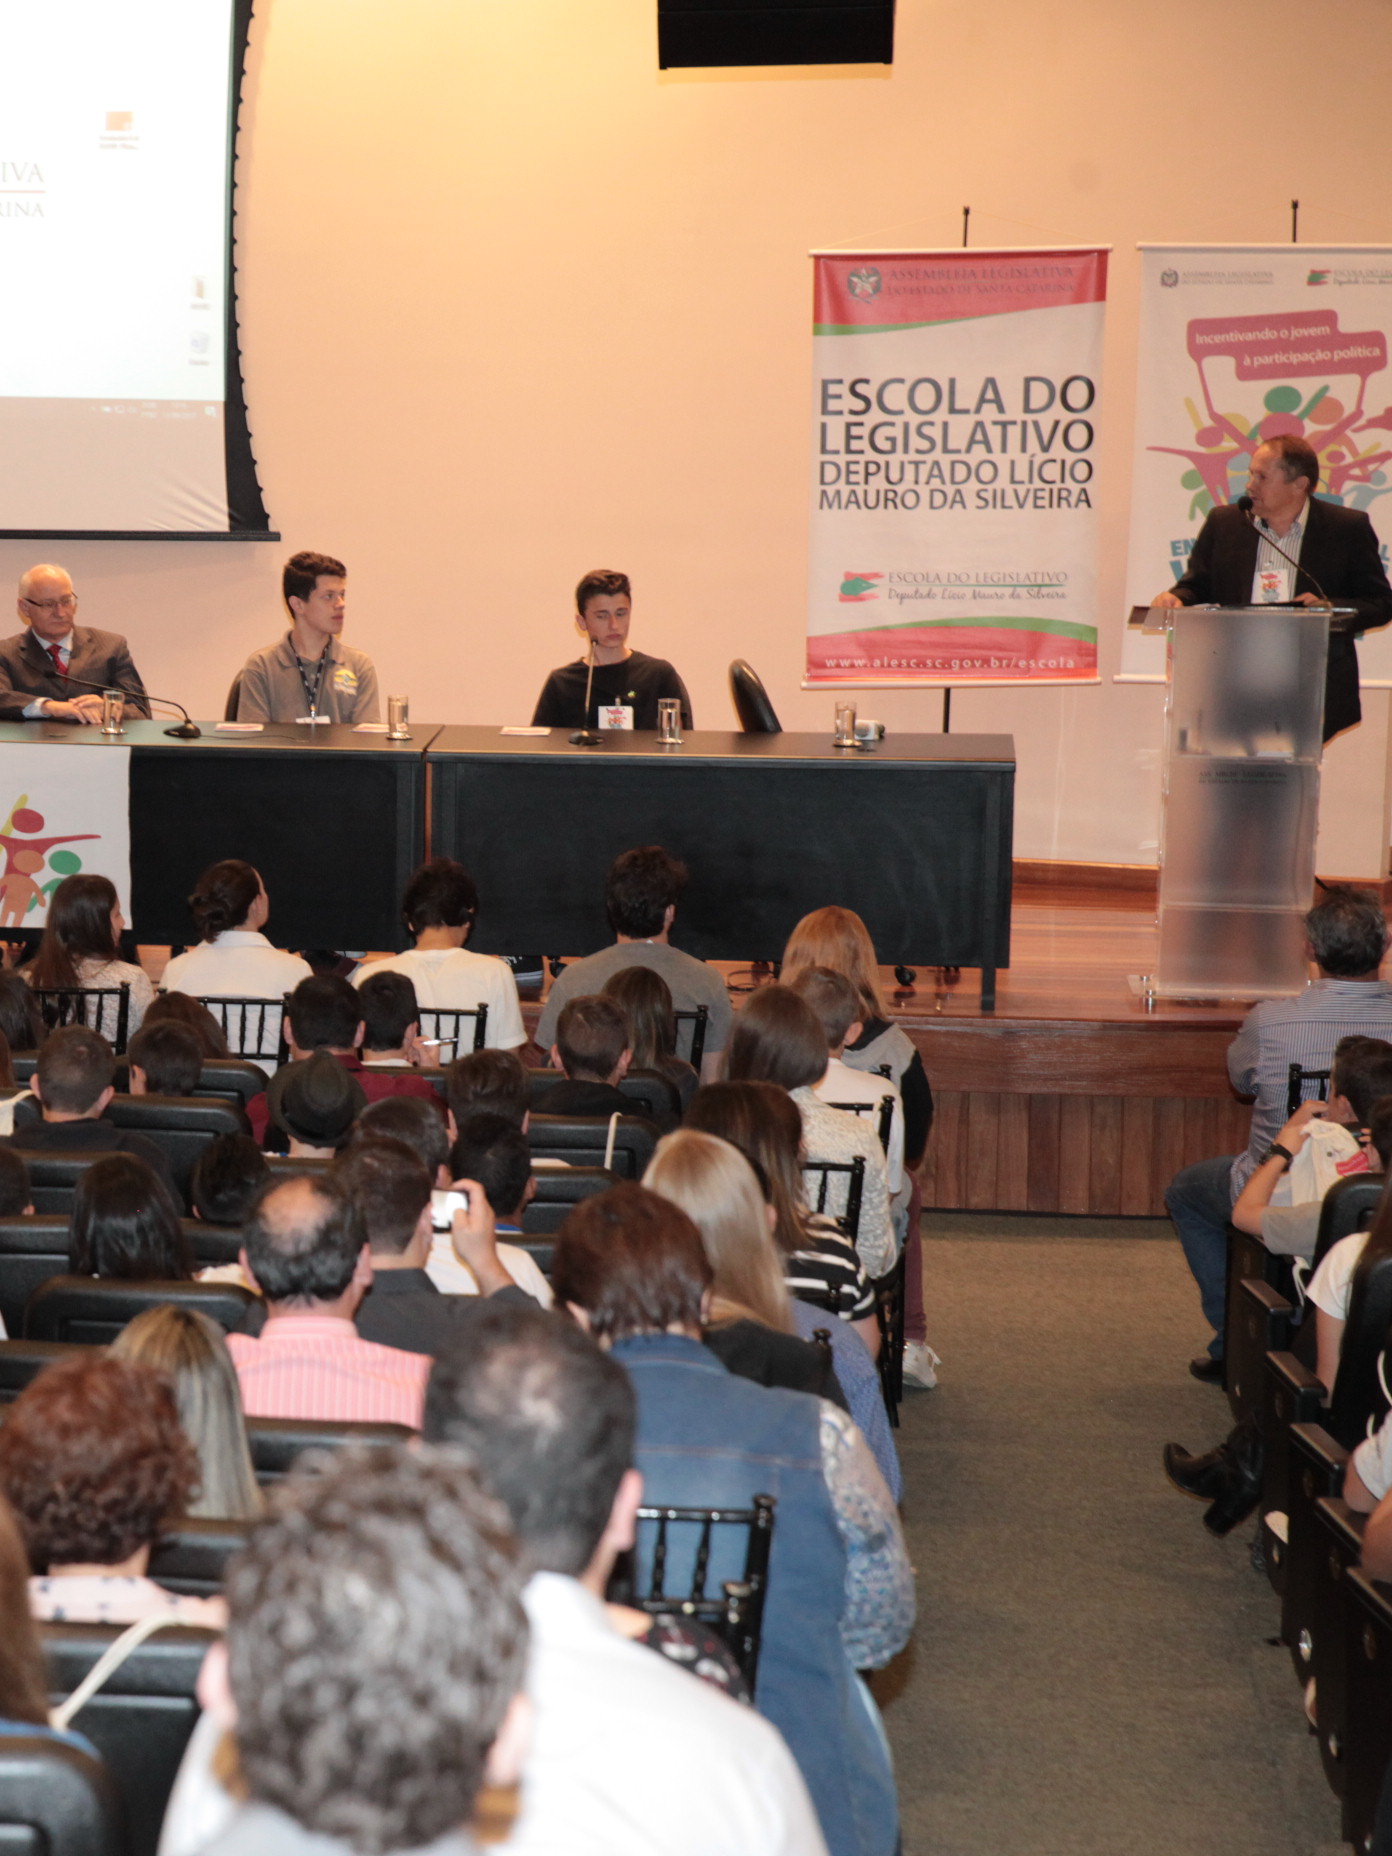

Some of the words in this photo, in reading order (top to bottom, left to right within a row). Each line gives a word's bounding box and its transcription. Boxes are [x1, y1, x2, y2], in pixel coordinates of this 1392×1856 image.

[982, 266, 1074, 280] LEGISLATIVA
[1195, 327, 1277, 345] Incentivando
[1280, 329, 1289, 339] o
[1290, 325, 1330, 341] jovem
[1243, 354, 1252, 367] à
[1253, 350, 1331, 368] participação
[1333, 345, 1381, 362] política
[821, 376, 1006, 416] ESCOLA
[1022, 374, 1096, 415] DO
[819, 418, 1095, 456] LEGISLATIVO
[819, 458, 999, 486] DEPUTADO
[1009, 453, 1094, 485] LÍCIO
[819, 488, 921, 510] MAURO
[928, 488, 967, 510] DA
[975, 487, 1093, 510] SILVEIRA
[888, 571, 942, 584] ESCOLA
[947, 571, 971, 584] DO
[975, 571, 1068, 583] LEGISLATIVO
[888, 587, 937, 605] Deputado
[1008, 587, 1022, 600] da
[1026, 586, 1067, 600] Silveira
[825, 655, 1075, 671] www.alesc.sc.gov.br/escola
